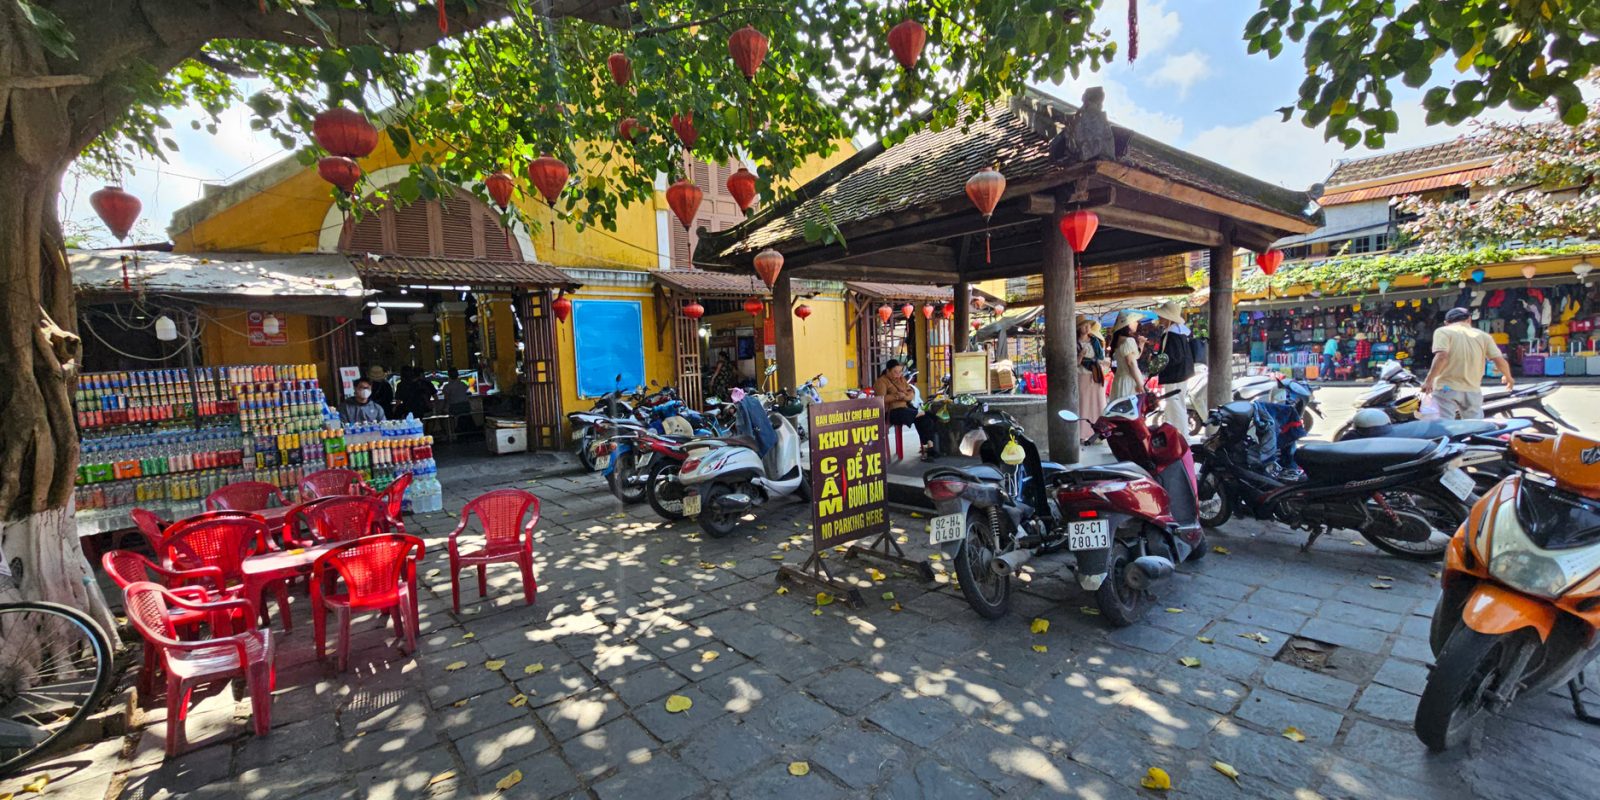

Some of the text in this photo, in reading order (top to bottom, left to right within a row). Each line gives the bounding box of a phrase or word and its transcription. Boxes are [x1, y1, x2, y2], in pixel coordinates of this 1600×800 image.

[816, 416, 827, 427] BAN
[872, 407, 880, 419] AN
[818, 425, 879, 450] KHU VỰC
[846, 447, 882, 481] ĐỂ XE
[819, 456, 843, 518] CẤM
[848, 476, 884, 509] BUÔN BÁN
[821, 508, 884, 540] NO PARKING HERE
[935, 515, 961, 530] 92-H4
[935, 526, 961, 541] 0490
[1074, 521, 1102, 535] 92-C1
[1071, 535, 1107, 549] 280.13
